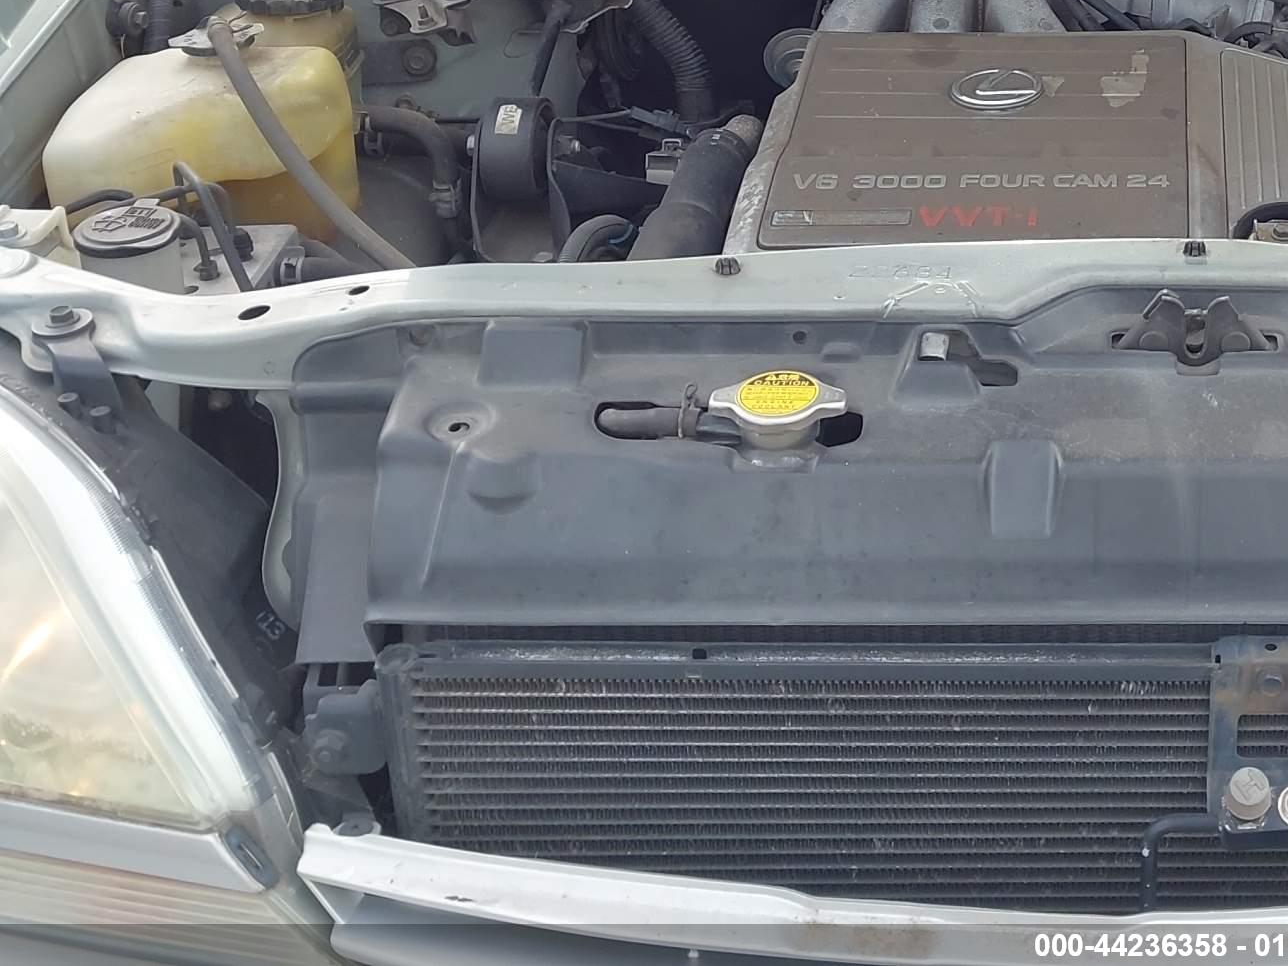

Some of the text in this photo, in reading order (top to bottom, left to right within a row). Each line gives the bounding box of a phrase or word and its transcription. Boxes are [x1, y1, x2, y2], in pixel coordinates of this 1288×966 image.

[793, 173, 1171, 190] V6 3000 FOUR CAM 24
[753, 379, 810, 387] CAUTION
